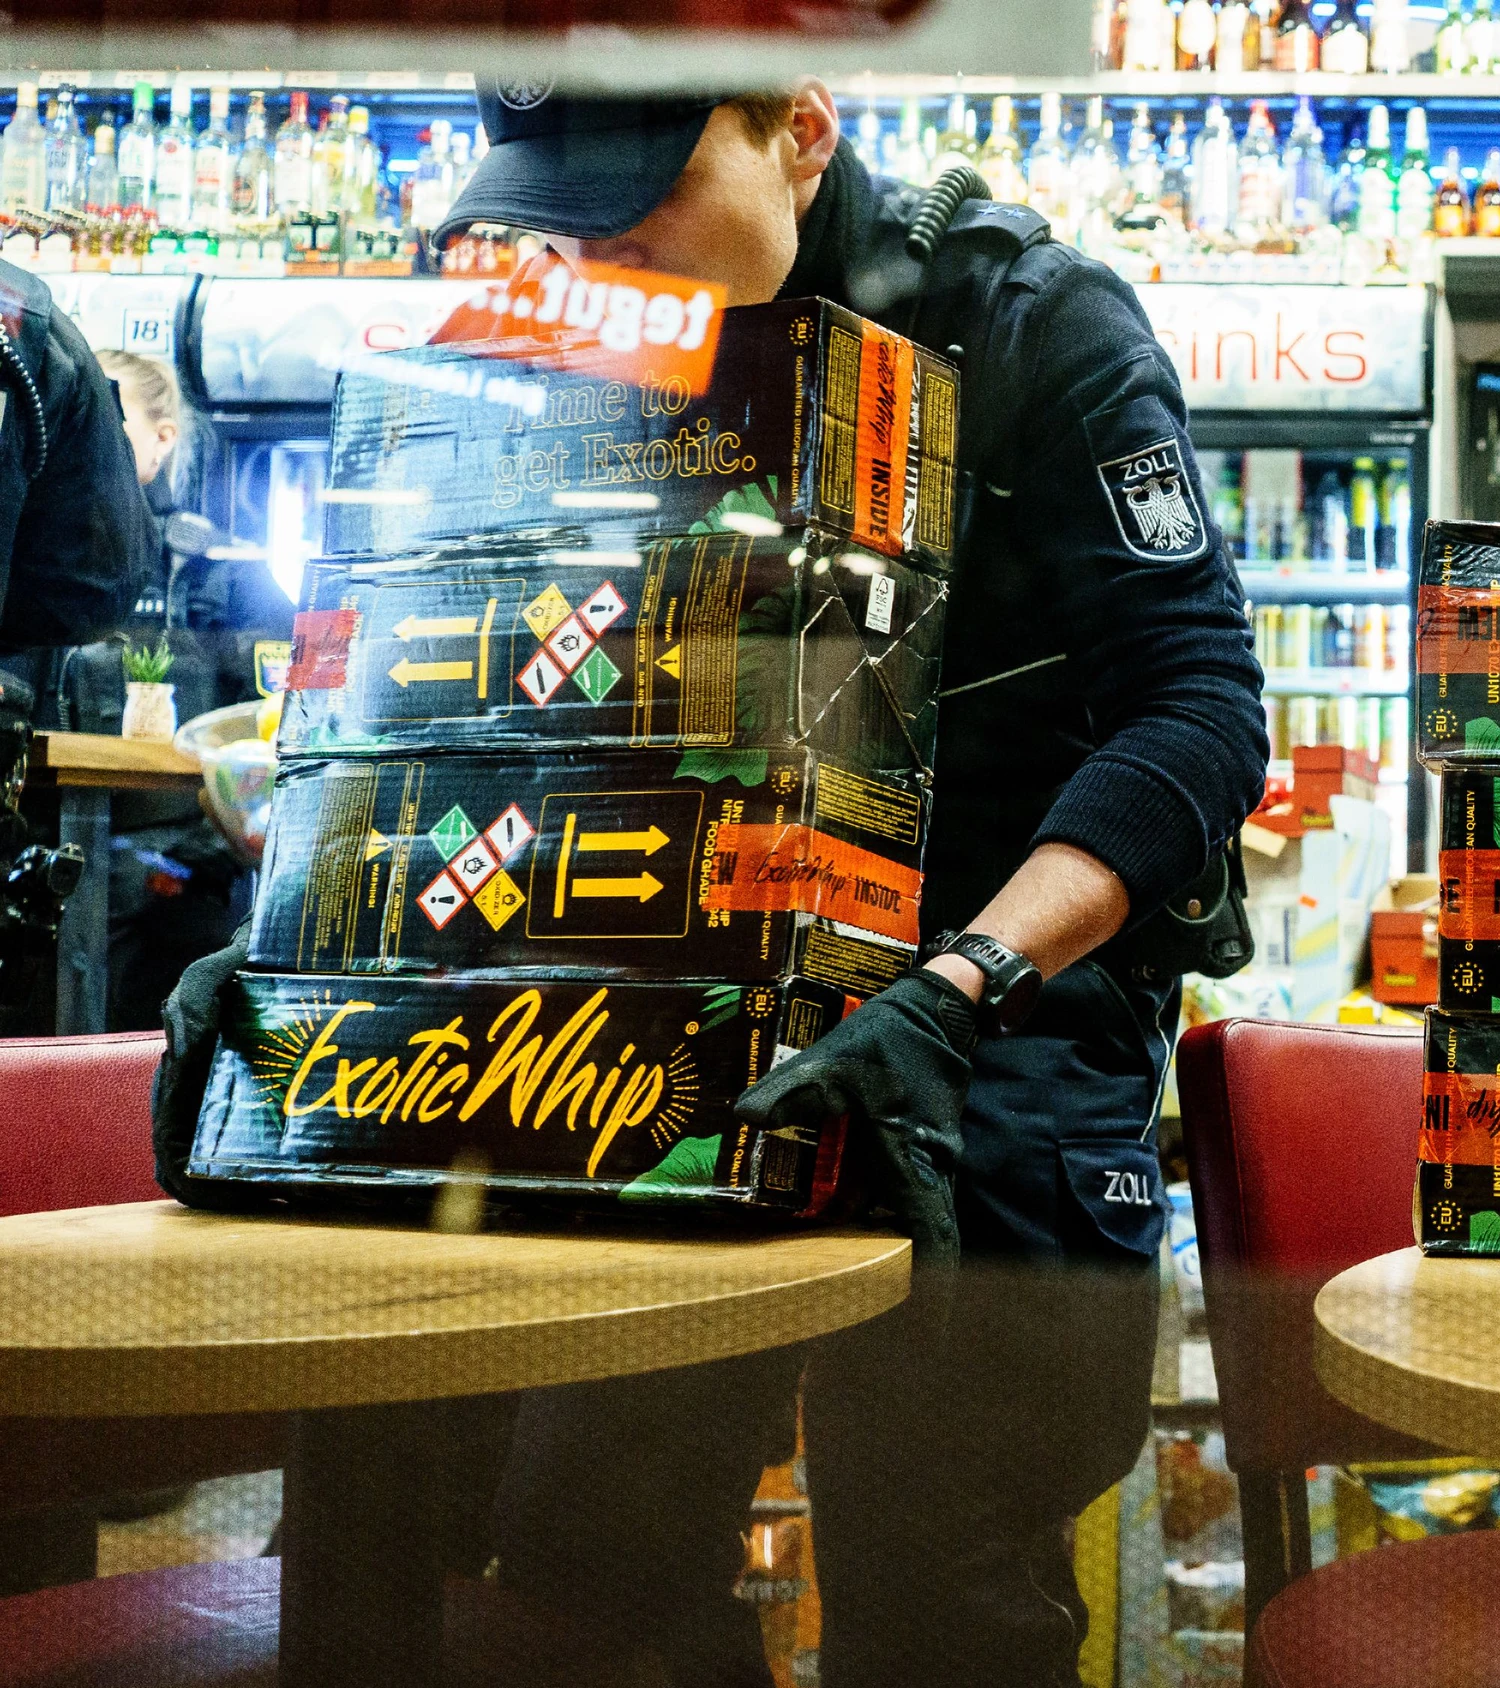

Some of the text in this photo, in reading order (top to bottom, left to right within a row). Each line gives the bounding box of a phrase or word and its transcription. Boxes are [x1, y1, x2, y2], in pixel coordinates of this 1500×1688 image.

[797, 322, 808, 340] EU
[504, 373, 627, 434] Time
[639, 370, 693, 419] to
[491, 417, 757, 510] get Exotic.
[1119, 450, 1176, 482] ZOLL
[869, 458, 891, 538] INSIDE
[665, 596, 678, 643] WARNING!
[1436, 714, 1447, 733] EU
[780, 771, 791, 788] EU
[1466, 790, 1476, 831] QUALITY
[698, 820, 719, 905] FOOD GRADE
[367, 863, 379, 909] WARNING!
[853, 874, 902, 915] INSIDE
[759, 920, 771, 961] QUALITY
[1462, 969, 1473, 987] EU
[755, 993, 768, 1012] EU
[1447, 1027, 1458, 1068] QUALITY
[729, 1148, 745, 1188] QUALITY
[1103, 1171, 1152, 1206] ZOLL
[1441, 1207, 1452, 1225] EU
